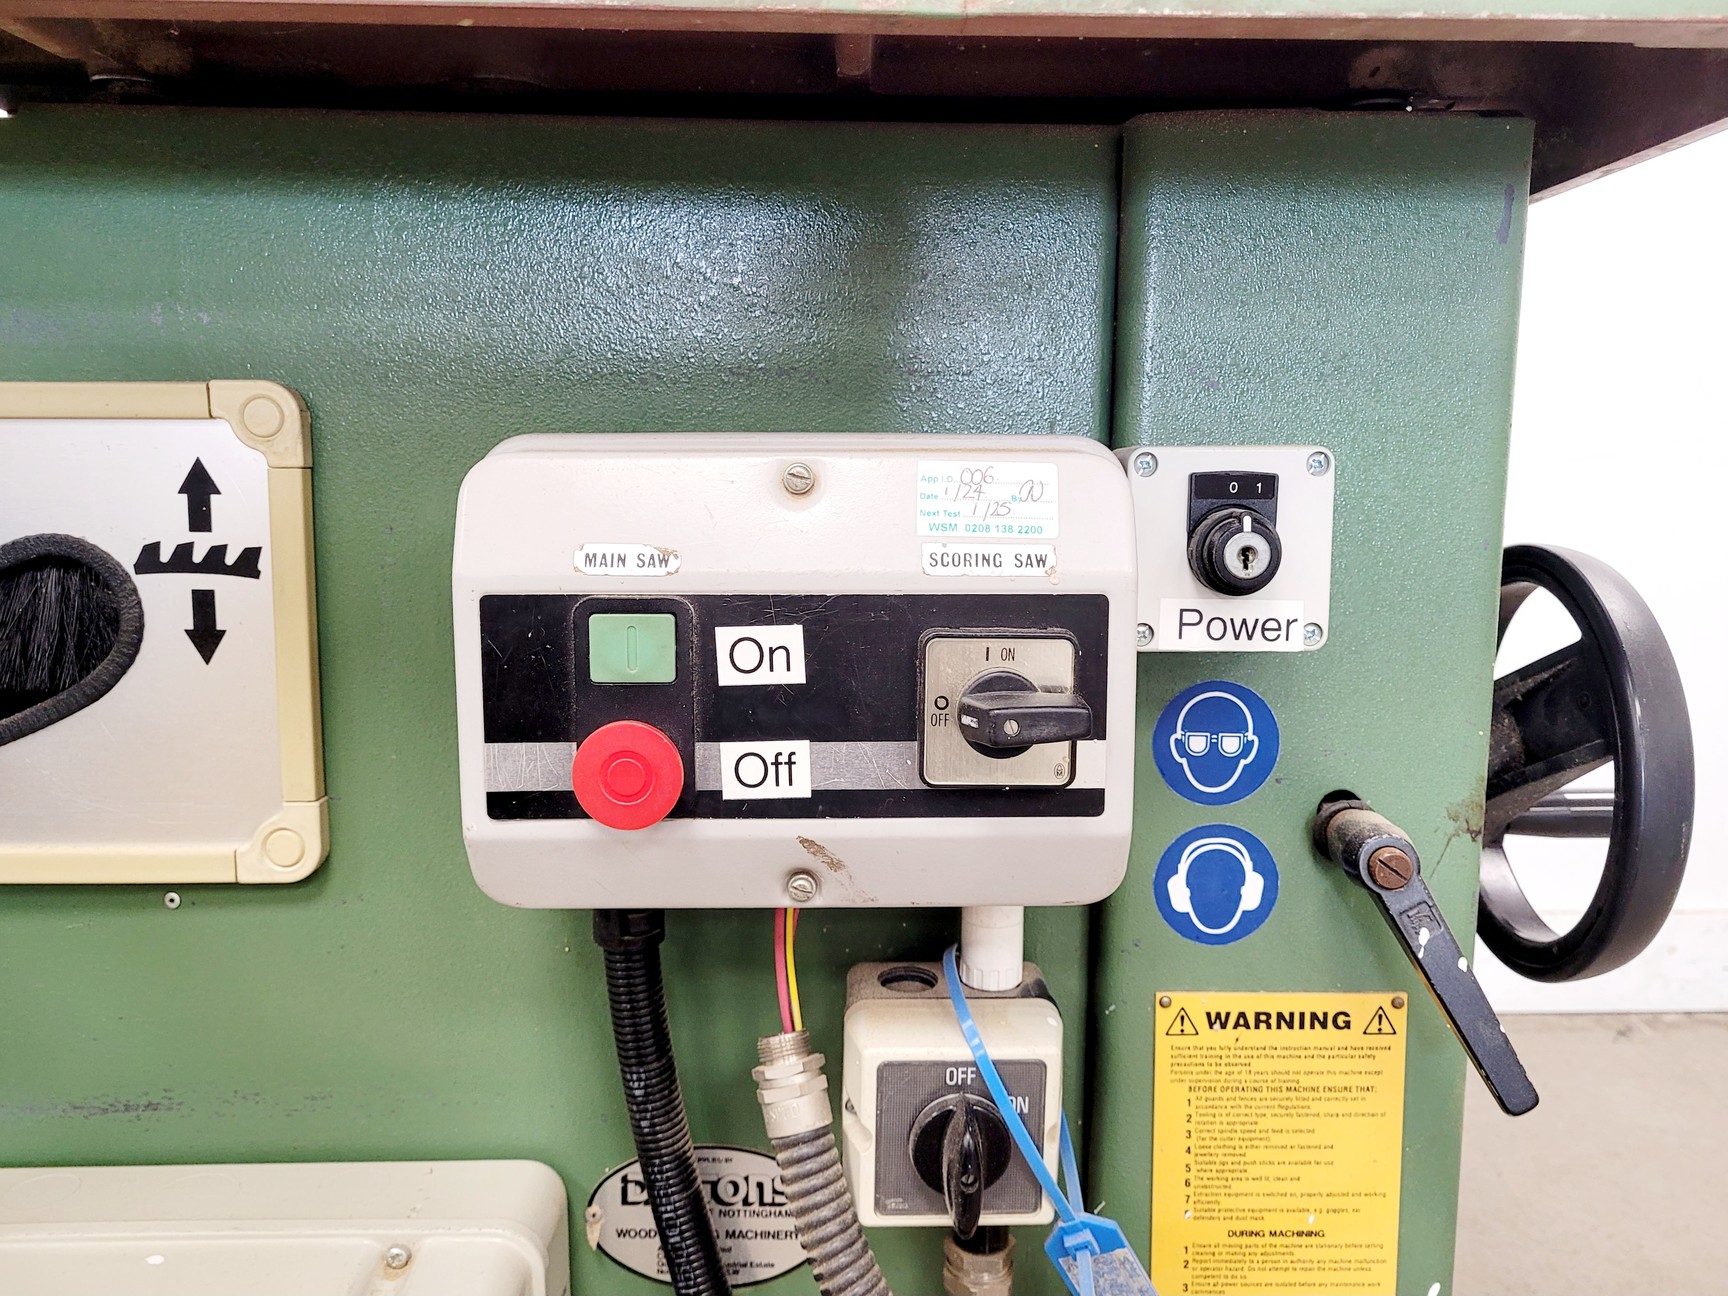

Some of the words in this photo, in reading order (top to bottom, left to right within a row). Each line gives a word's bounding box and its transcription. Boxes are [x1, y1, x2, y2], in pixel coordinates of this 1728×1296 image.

[960, 466, 995, 485] 006
[919, 492, 939, 500] Date
[919, 509, 940, 517] Next
[928, 522, 958, 532] WSM
[964, 523, 991, 533] 0208
[995, 524, 1014, 534] 138
[1017, 525, 1043, 534] 2200
[584, 552, 627, 568] MAIN
[636, 552, 671, 568] SAW
[929, 552, 1002, 568] SCORING
[1014, 552, 1048, 568] SAW
[1178, 608, 1298, 642] Power
[729, 636, 791, 674] On
[1000, 647, 1016, 662] ON
[930, 713, 950, 727] OFF
[734, 751, 797, 788] Off
[1205, 1011, 1351, 1030] WARNING
[945, 1067, 976, 1086] OFF
[1188, 1085, 1217, 1093] BEFORE
[1220, 1085, 1263, 1093] OPERATING
[1266, 1085, 1283, 1093] THIS
[1285, 1085, 1320, 1093] MACHINE
[1323, 1085, 1353, 1093] ENSURE
[1187, 1099, 1191, 1107] 1
[1186, 1114, 1192, 1123] 2
[1185, 1130, 1192, 1139] 3
[1185, 1146, 1191, 1154] 4
[1185, 1163, 1191, 1173] 5
[1184, 1178, 1191, 1188] 6
[1185, 1195, 1190, 1204] 7
[725, 1229, 800, 1240] MACHINERY
[1227, 1229, 1265, 1238] DURING
[1269, 1229, 1325, 1238] MACHINING
[1184, 1246, 1188, 1254] 1
[1183, 1260, 1189, 1268] 2
[1182, 1283, 1188, 1292] 3
